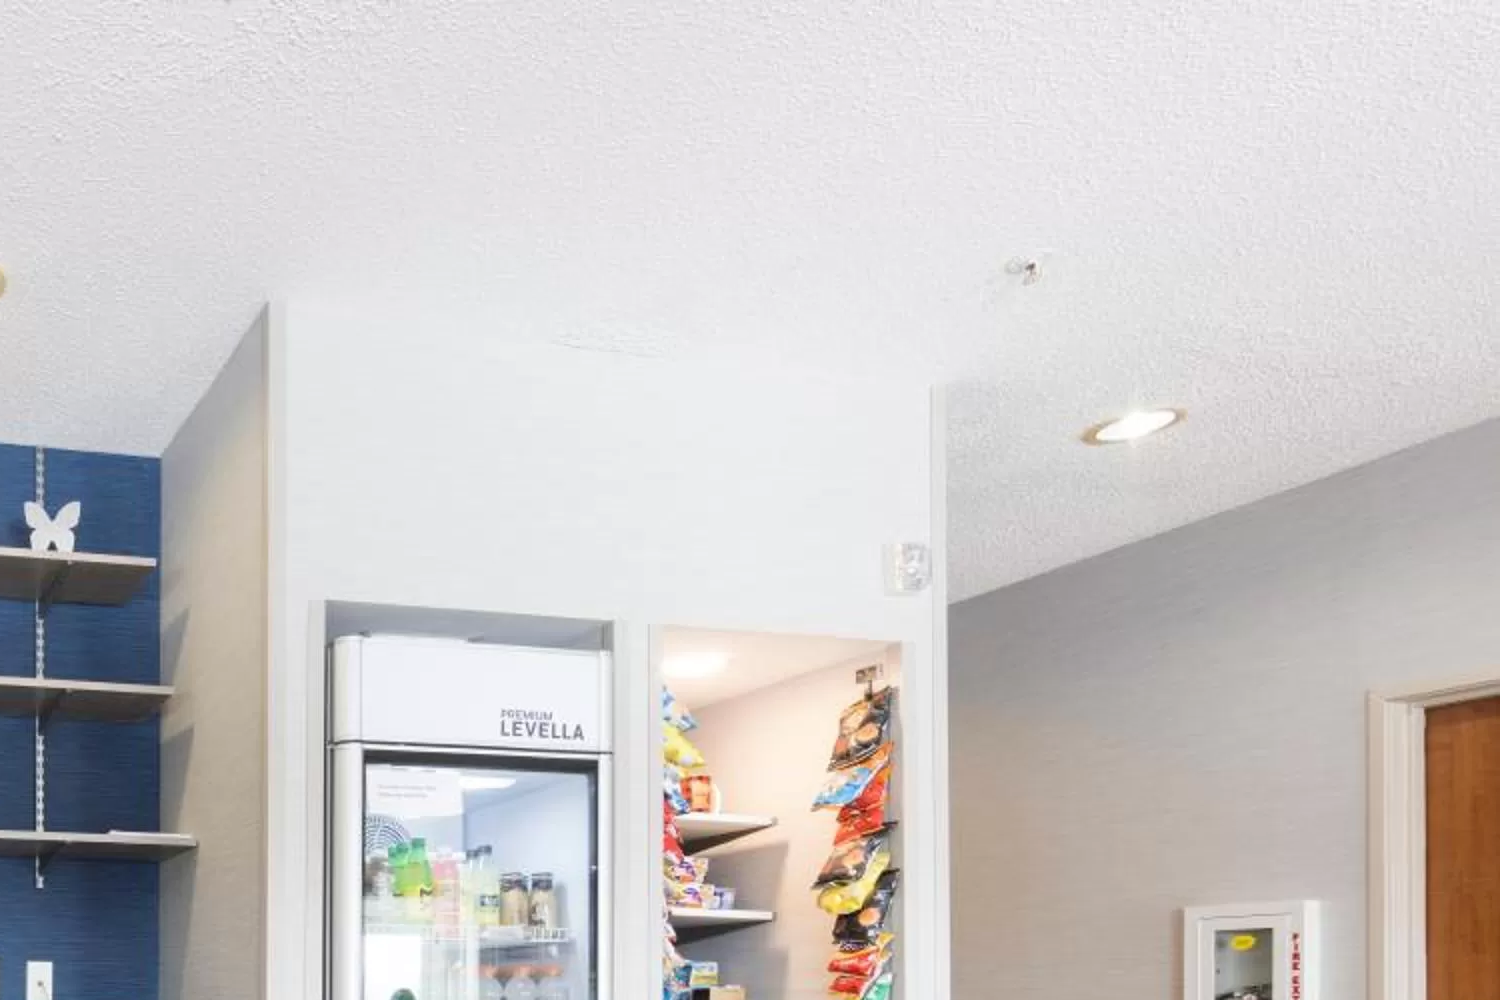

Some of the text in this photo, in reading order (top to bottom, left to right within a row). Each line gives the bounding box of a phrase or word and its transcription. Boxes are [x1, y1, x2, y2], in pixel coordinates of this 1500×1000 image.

[500, 708, 553, 721] PREMIUM
[500, 720, 585, 741] LEVELLA
[1291, 932, 1301, 971] FIRE
